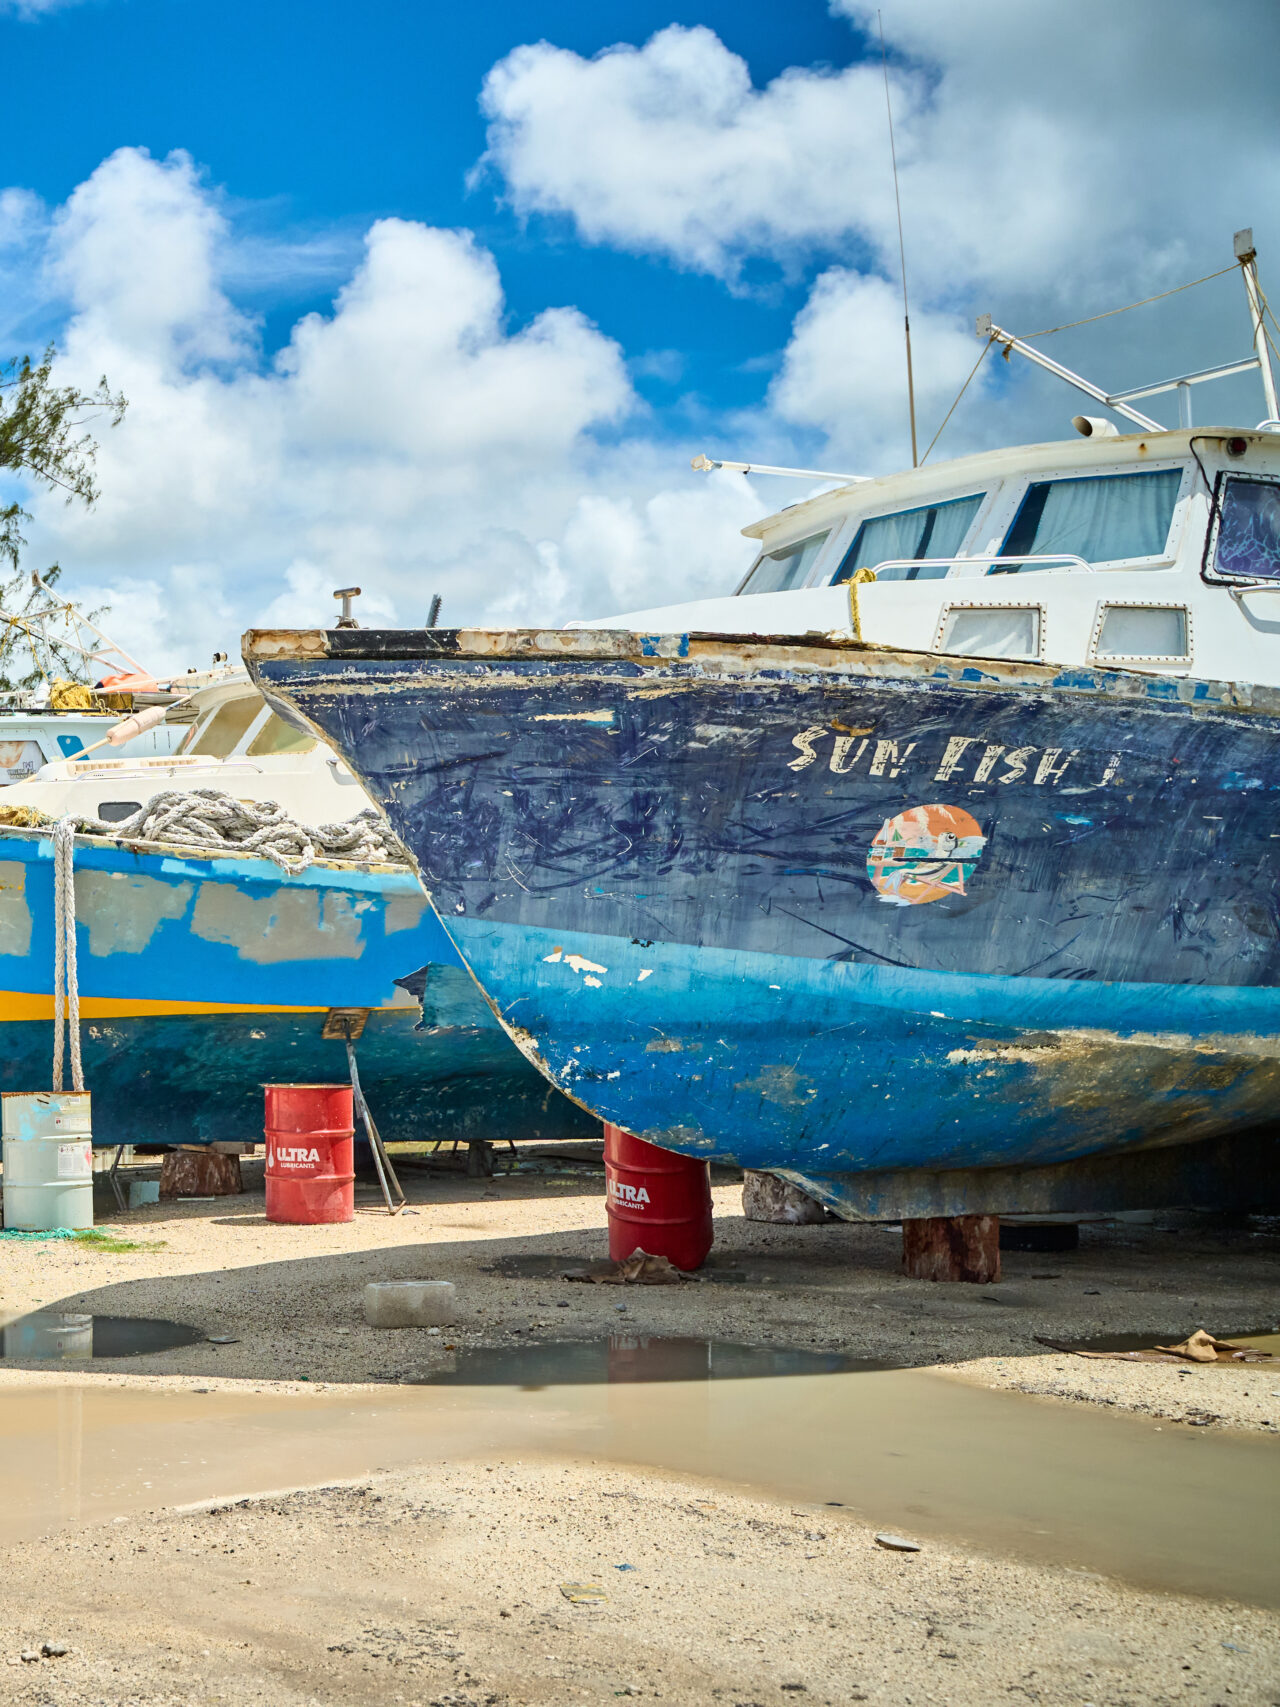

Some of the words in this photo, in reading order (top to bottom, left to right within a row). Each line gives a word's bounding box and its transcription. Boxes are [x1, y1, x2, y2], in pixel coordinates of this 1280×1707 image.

[787, 726, 917, 778] SUN
[933, 736, 1080, 785] FISH
[276, 1147, 321, 1163] ULTRA
[609, 1179, 651, 1203] ULTRA
